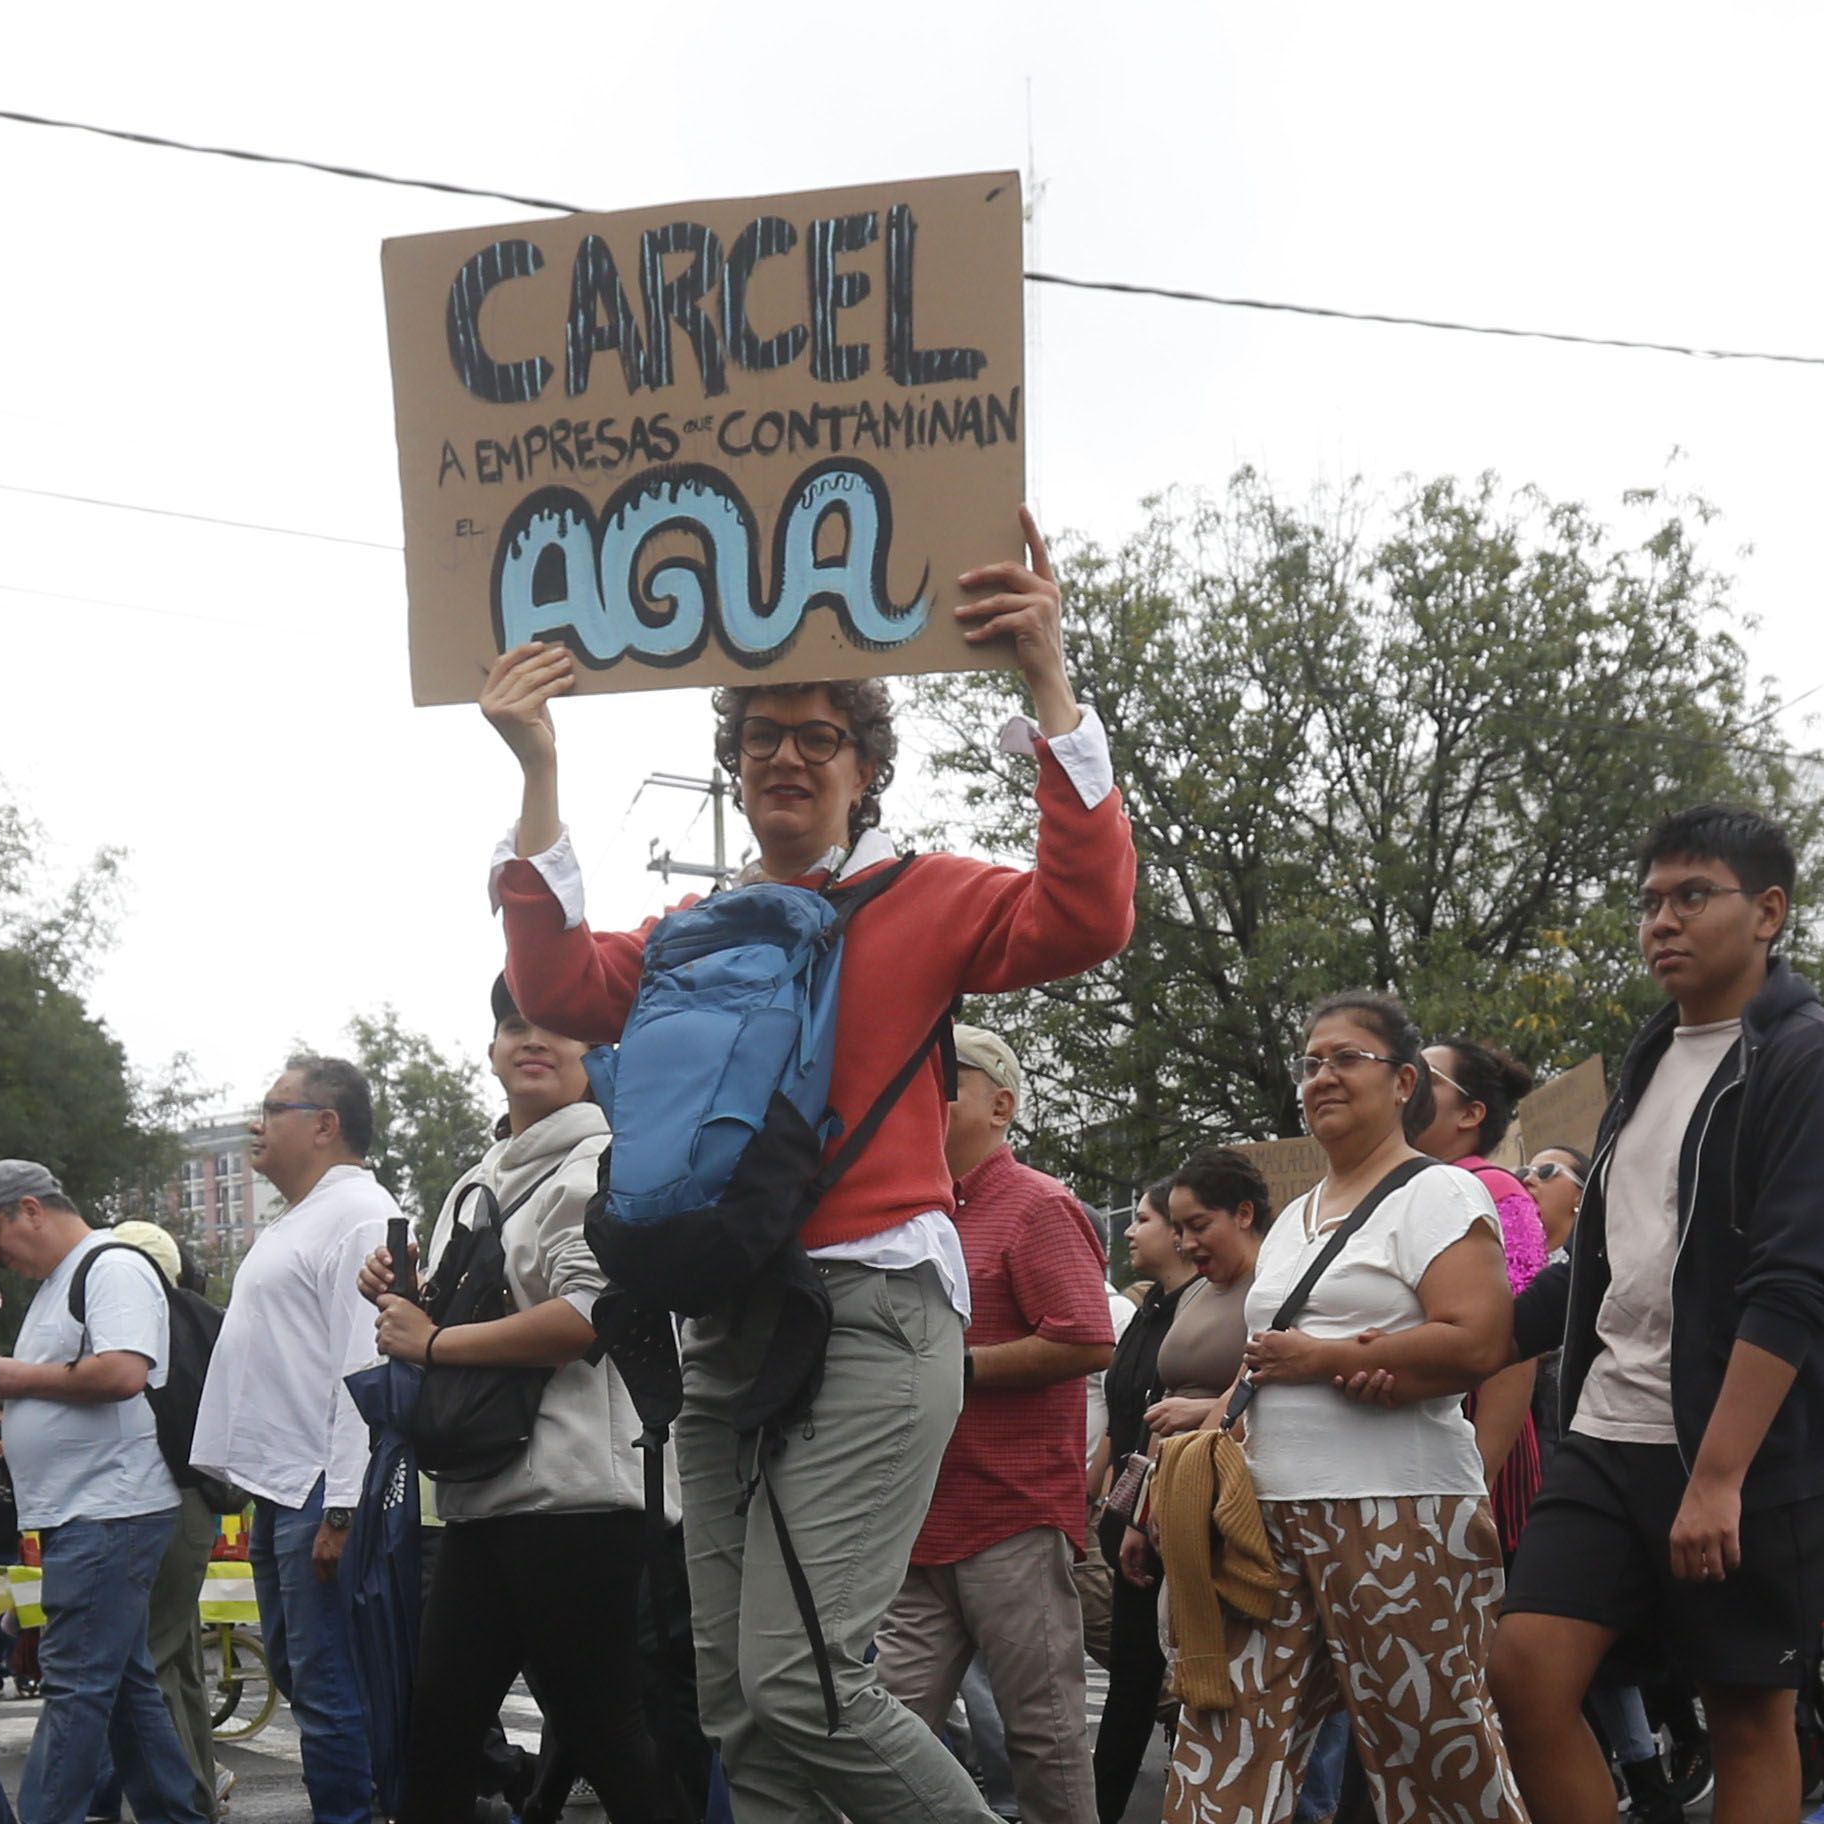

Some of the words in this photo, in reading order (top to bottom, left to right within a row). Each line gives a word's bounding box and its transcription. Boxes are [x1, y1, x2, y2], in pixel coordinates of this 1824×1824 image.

[446, 203, 988, 404] CARCEL
[437, 438, 467, 489] A
[475, 413, 681, 485] EMPRESAS
[682, 414, 715, 434] QUE
[455, 518, 485, 537] EL
[489, 456, 939, 671] AGUA
